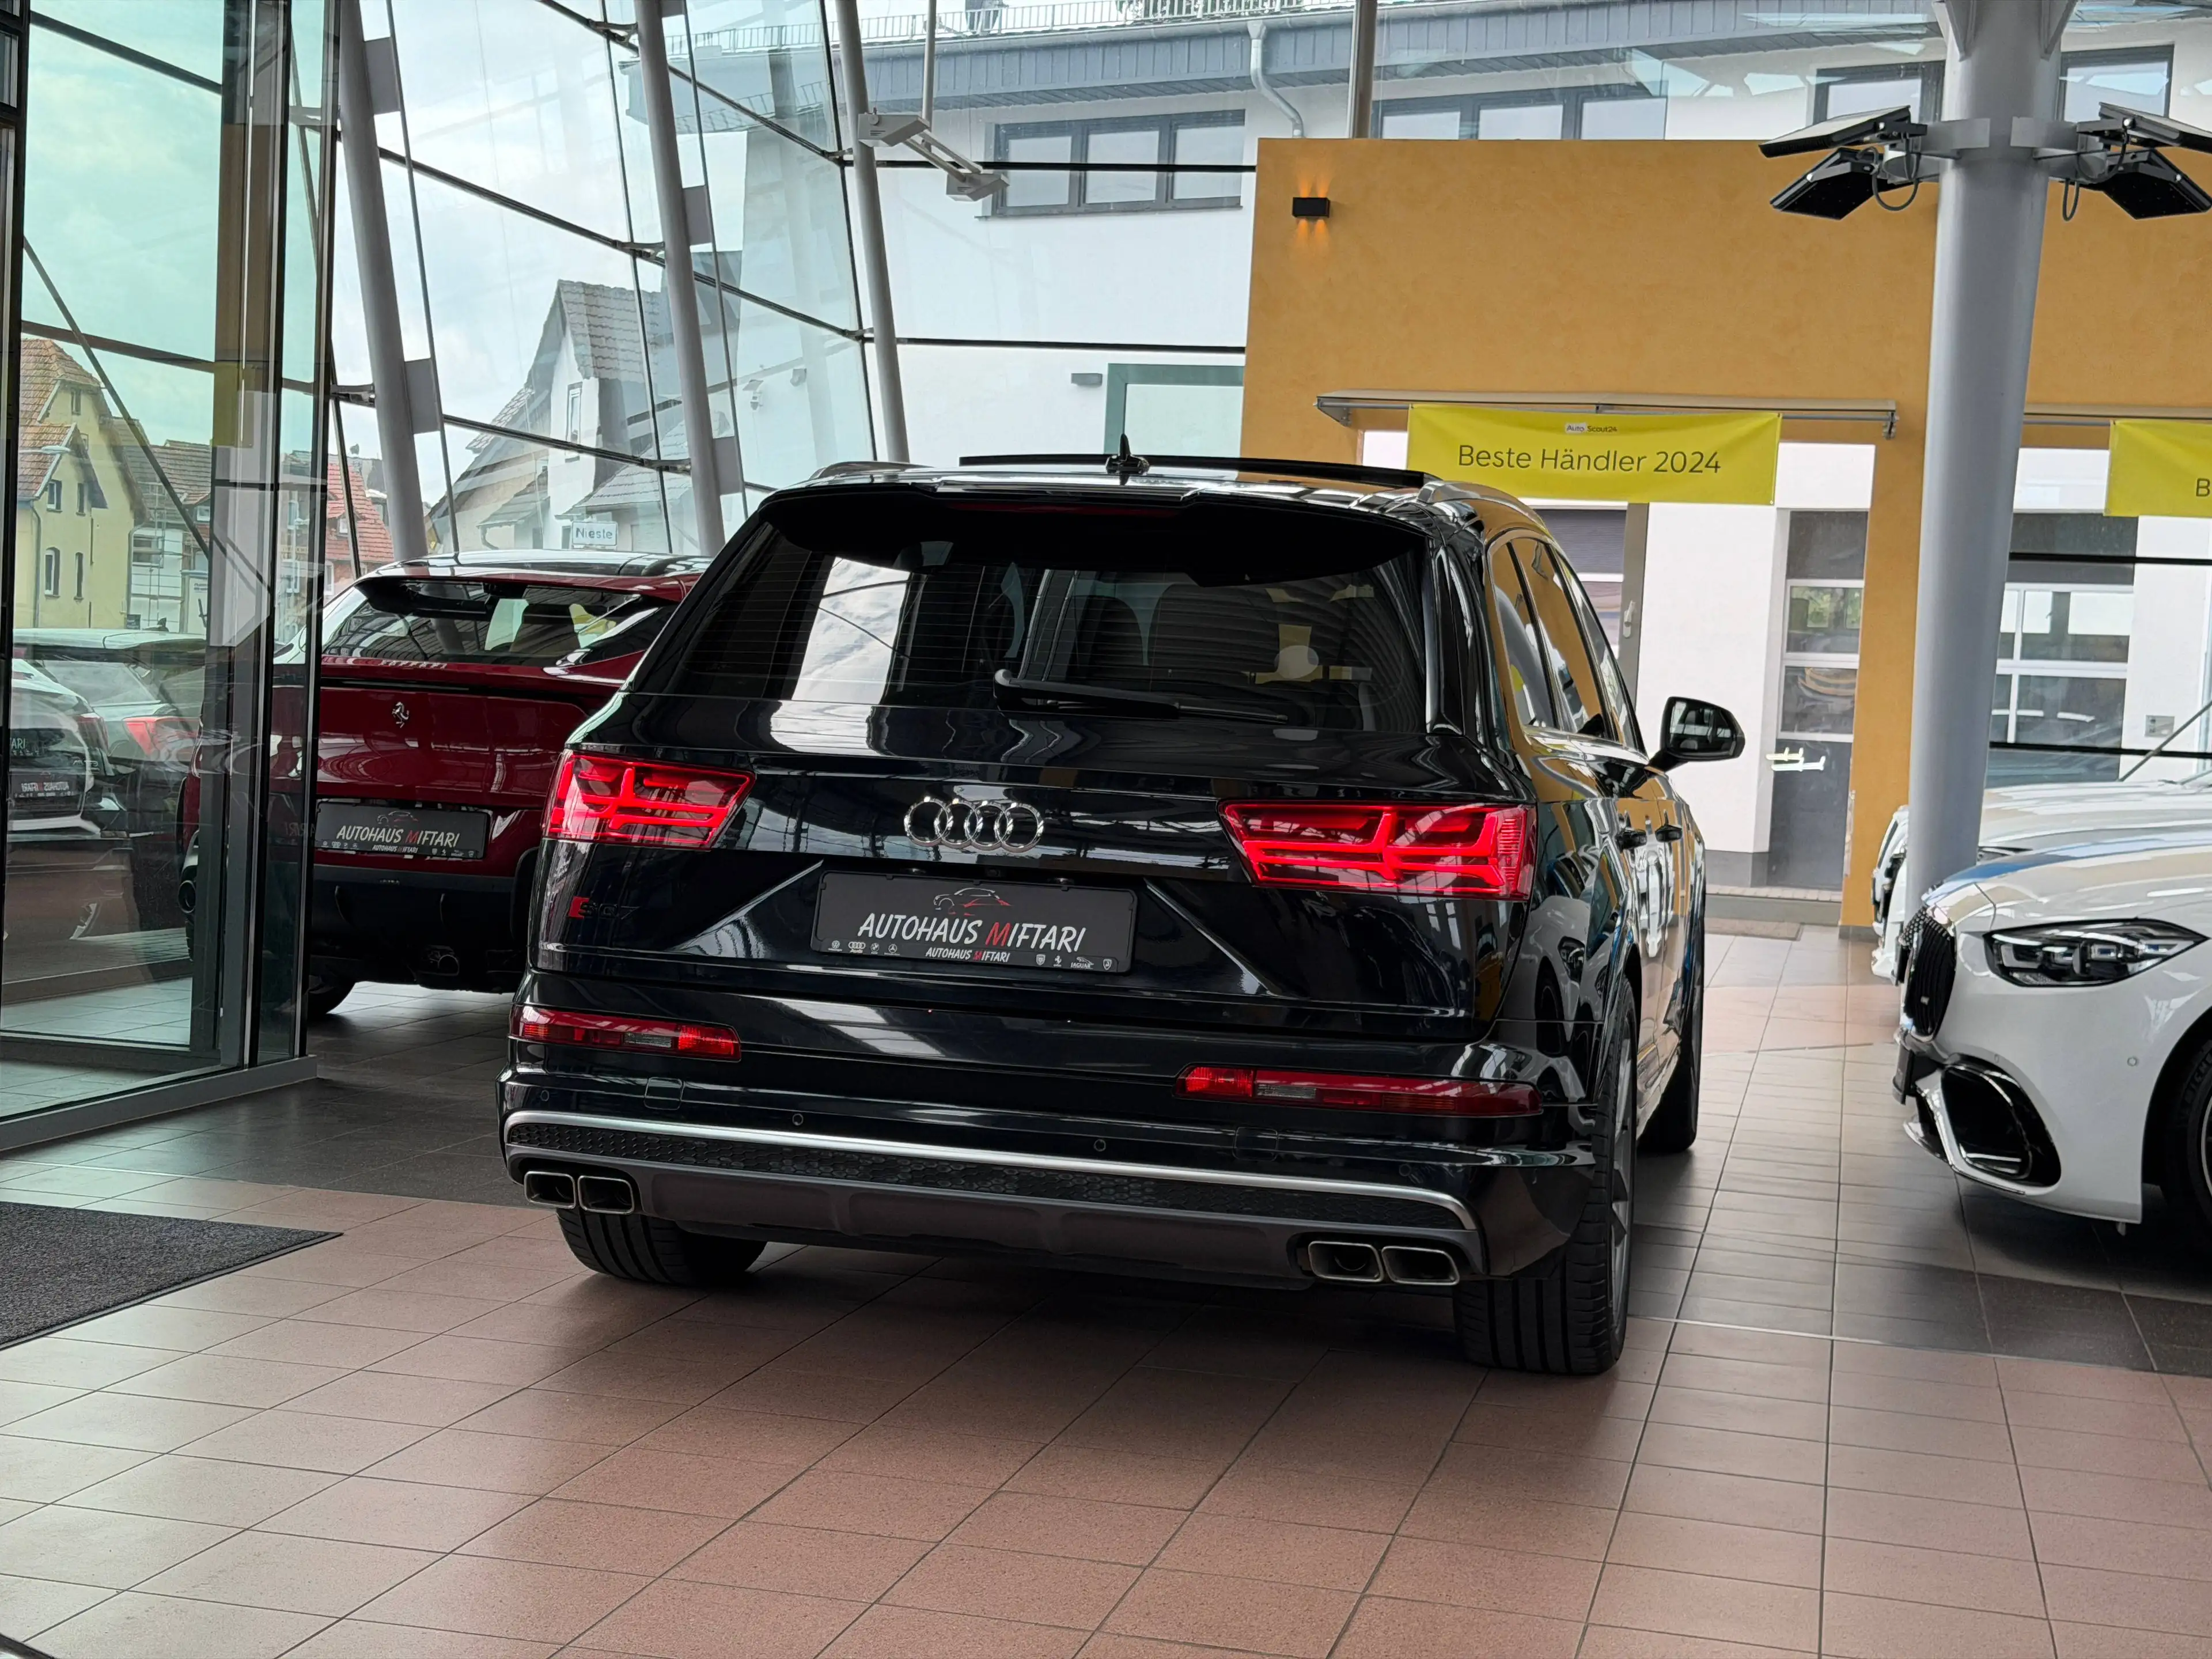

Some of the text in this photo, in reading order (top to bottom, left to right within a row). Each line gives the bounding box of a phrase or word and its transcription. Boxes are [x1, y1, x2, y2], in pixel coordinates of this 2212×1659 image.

[1459, 444, 1721, 474] Beste Händler 2024
[2195, 478, 2210, 497] B
[336, 825, 404, 843] AUTOHAUS
[404, 830, 461, 848] MIFTARI
[857, 912, 1087, 953] AUTOHAUS MIFTARI
[925, 947, 1010, 963] AUTOHAUS MIFTARI
